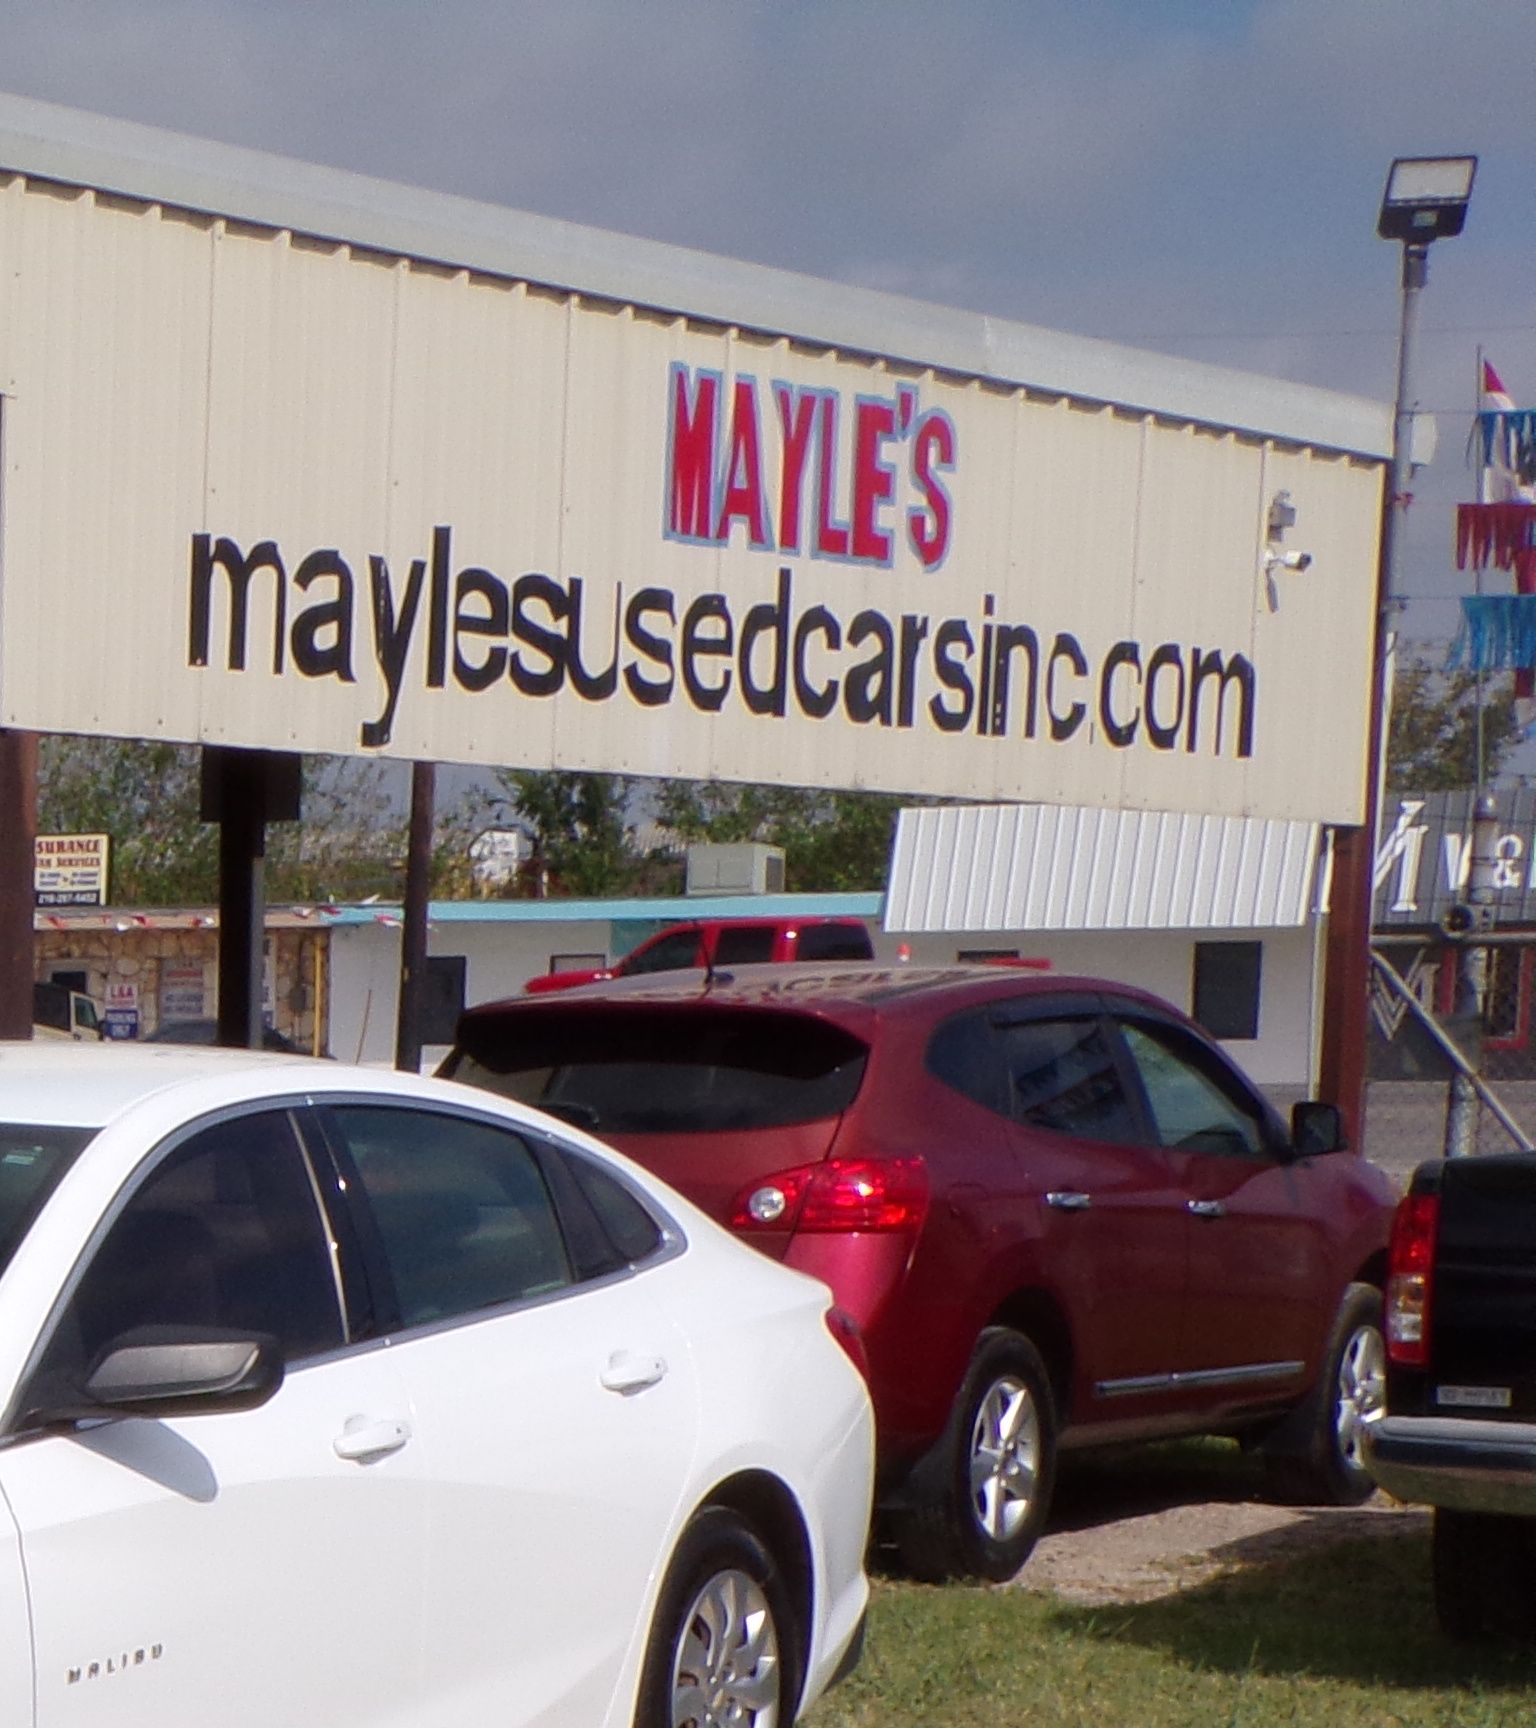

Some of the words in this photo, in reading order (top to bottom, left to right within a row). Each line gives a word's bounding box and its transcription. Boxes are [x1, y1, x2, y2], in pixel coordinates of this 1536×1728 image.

[665, 364, 955, 571] MAYLE'S
[187, 526, 1256, 758] maylesusedcarsinc.com
[67, 1643, 163, 1684] MALIBU
